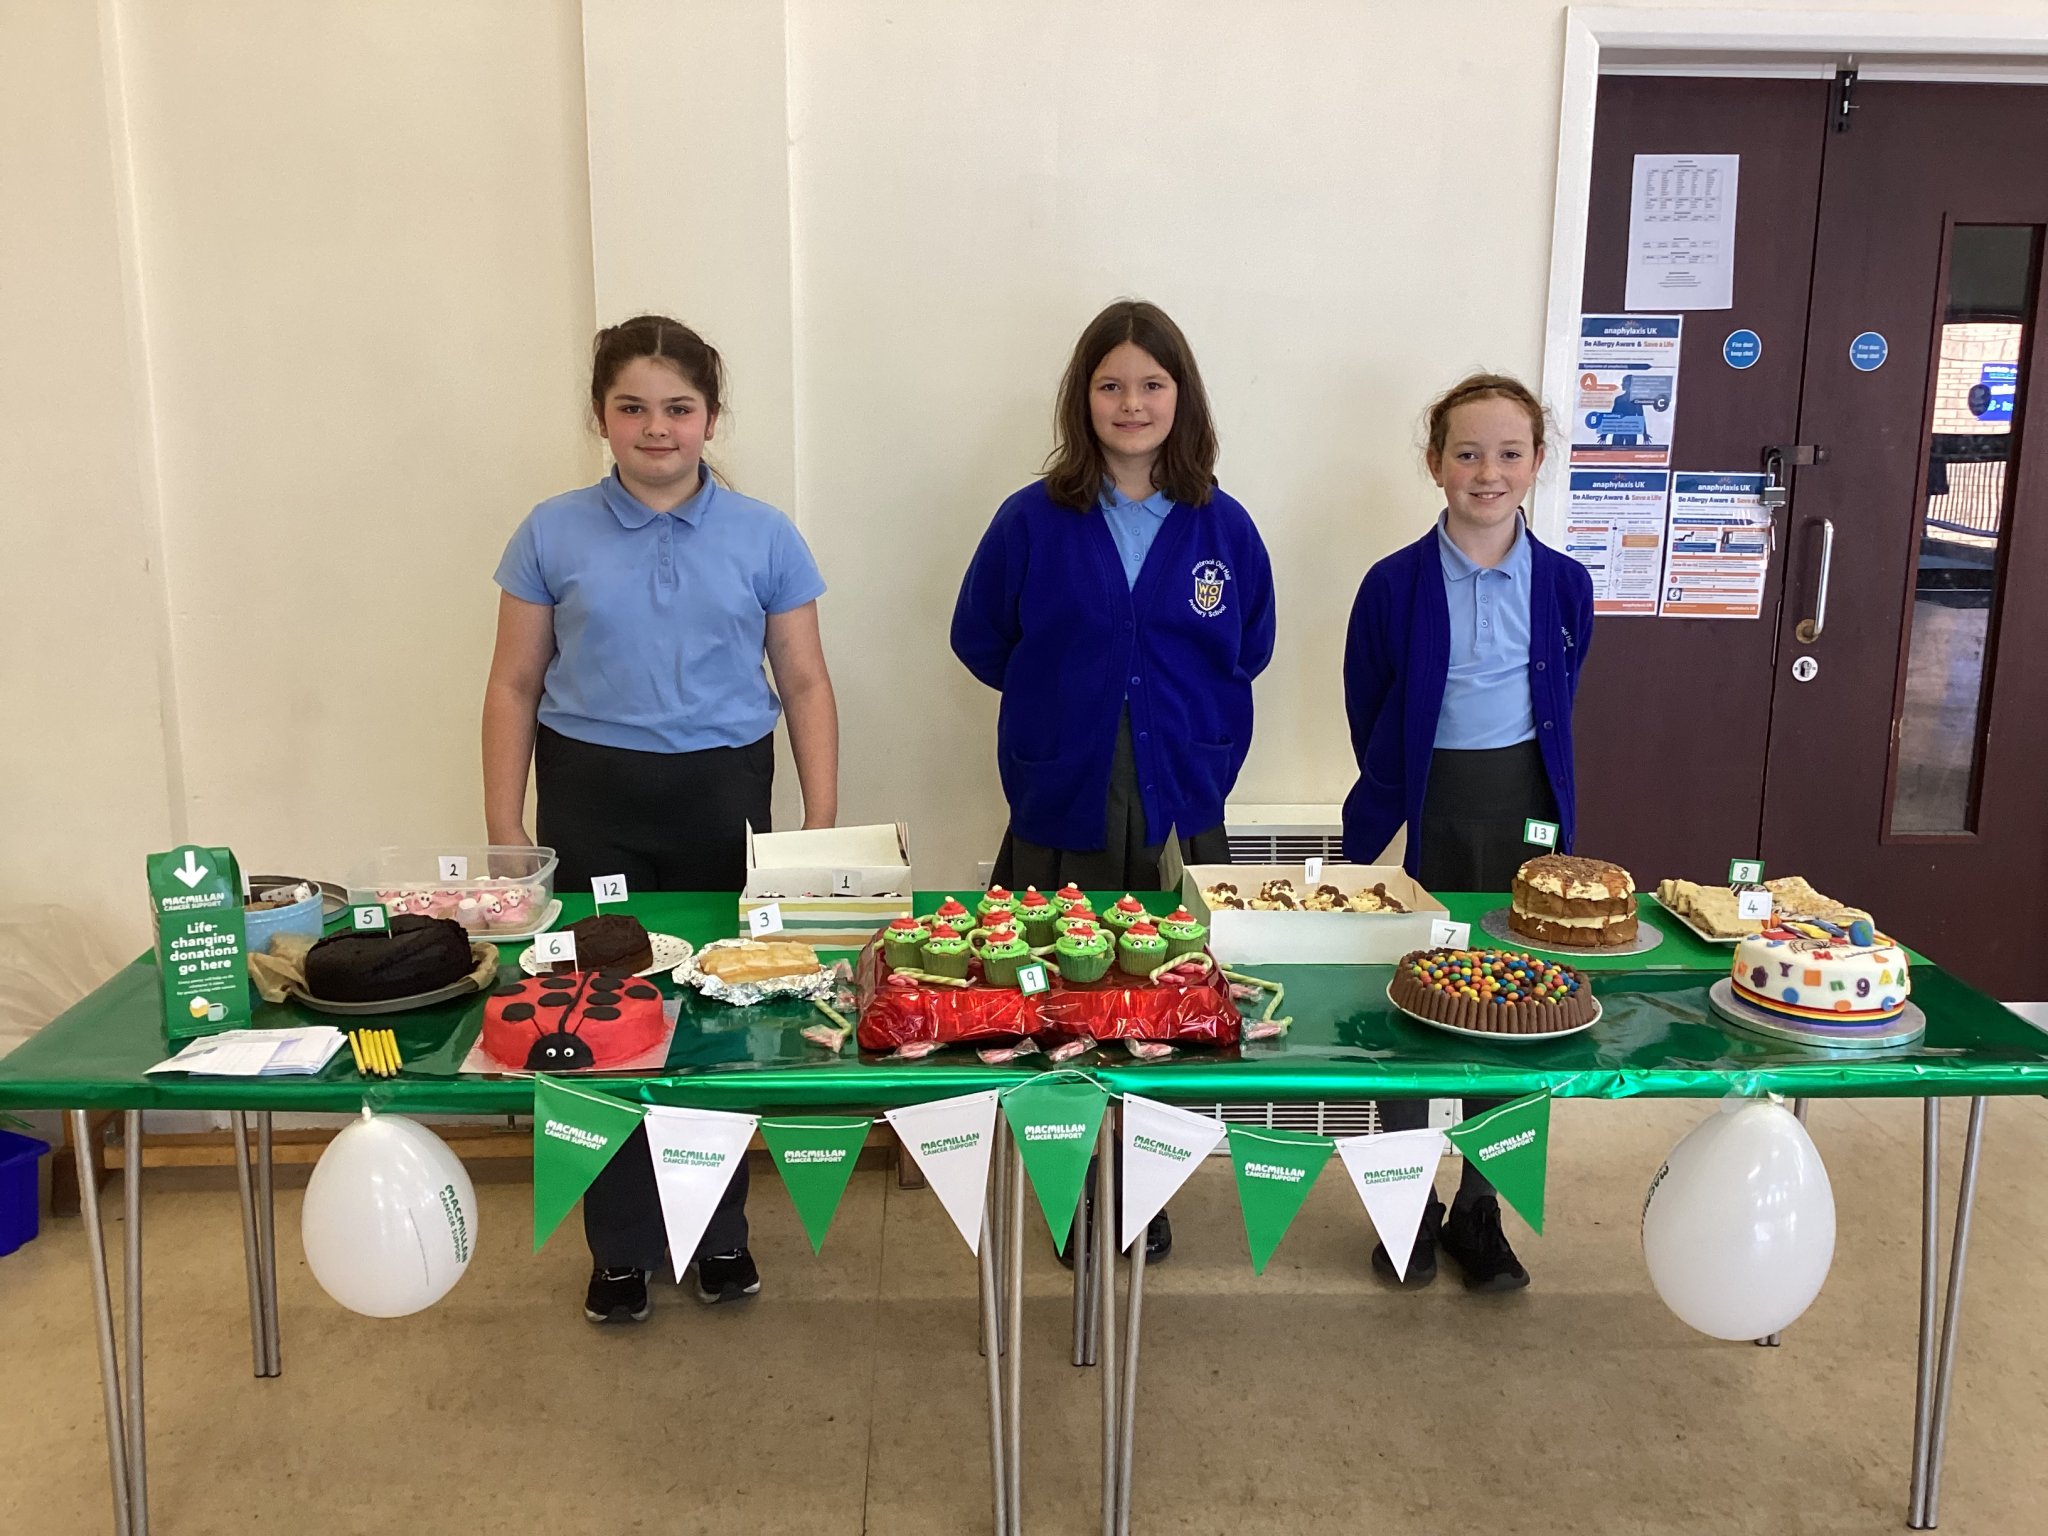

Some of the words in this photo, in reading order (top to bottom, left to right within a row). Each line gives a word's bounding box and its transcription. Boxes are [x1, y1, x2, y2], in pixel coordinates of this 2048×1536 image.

[1592, 481, 1633, 489] anaphylaxis
[1698, 484, 1739, 492] anaphylaxis
[1208, 604, 1227, 617] School
[1534, 826, 1547, 840] 13
[450, 864, 458, 876] 2
[1740, 867, 1749, 880] 8
[604, 882, 620, 896] 12
[841, 876, 850, 888] 1
[162, 892, 224, 906] MACMILLAN
[1748, 900, 1758, 913] 4
[362, 910, 373, 925] 5
[760, 912, 770, 928] 3
[187, 922, 218, 934] Life-
[171, 933, 235, 948] changing
[1444, 928, 1456, 944] 7
[170, 946, 238, 961] donations
[549, 939, 561, 955] 6
[179, 964, 197, 975] go
[201, 960, 231, 970] here
[1779, 962, 1794, 977] Y
[1027, 971, 1037, 988] 9
[1879, 969, 1893, 985] A
[1856, 978, 1870, 997] 9
[1881, 996, 1896, 1011] C
[546, 1120, 608, 1145] MACMILLAN
[1025, 1124, 1086, 1134] MACMILLAN
[545, 1129, 570, 1141] CANCER
[571, 1137, 601, 1150] SUPPORT
[921, 1132, 979, 1150] MACMILLAN
[1135, 1135, 1191, 1157] MACMILLAN
[1479, 1129, 1536, 1157] MACMILLAN
[663, 1148, 725, 1162] MACMILLAN
[784, 1150, 846, 1158] MACMILLAN
[923, 1147, 948, 1156] CANCER
[949, 1141, 977, 1150] SUPPORT
[1133, 1143, 1157, 1153] CANCER
[1159, 1150, 1186, 1162] SUPPORT
[1482, 1148, 1506, 1161] CANCER
[1506, 1137, 1534, 1151] SUPPORT
[1245, 1162, 1305, 1177] MACMILLAN
[1364, 1166, 1423, 1180] MACMILLAN
[1272, 1174, 1300, 1182] SUPPORT
[440, 1191, 455, 1228] CANCER
[445, 1184, 468, 1263] MACMILLAN
